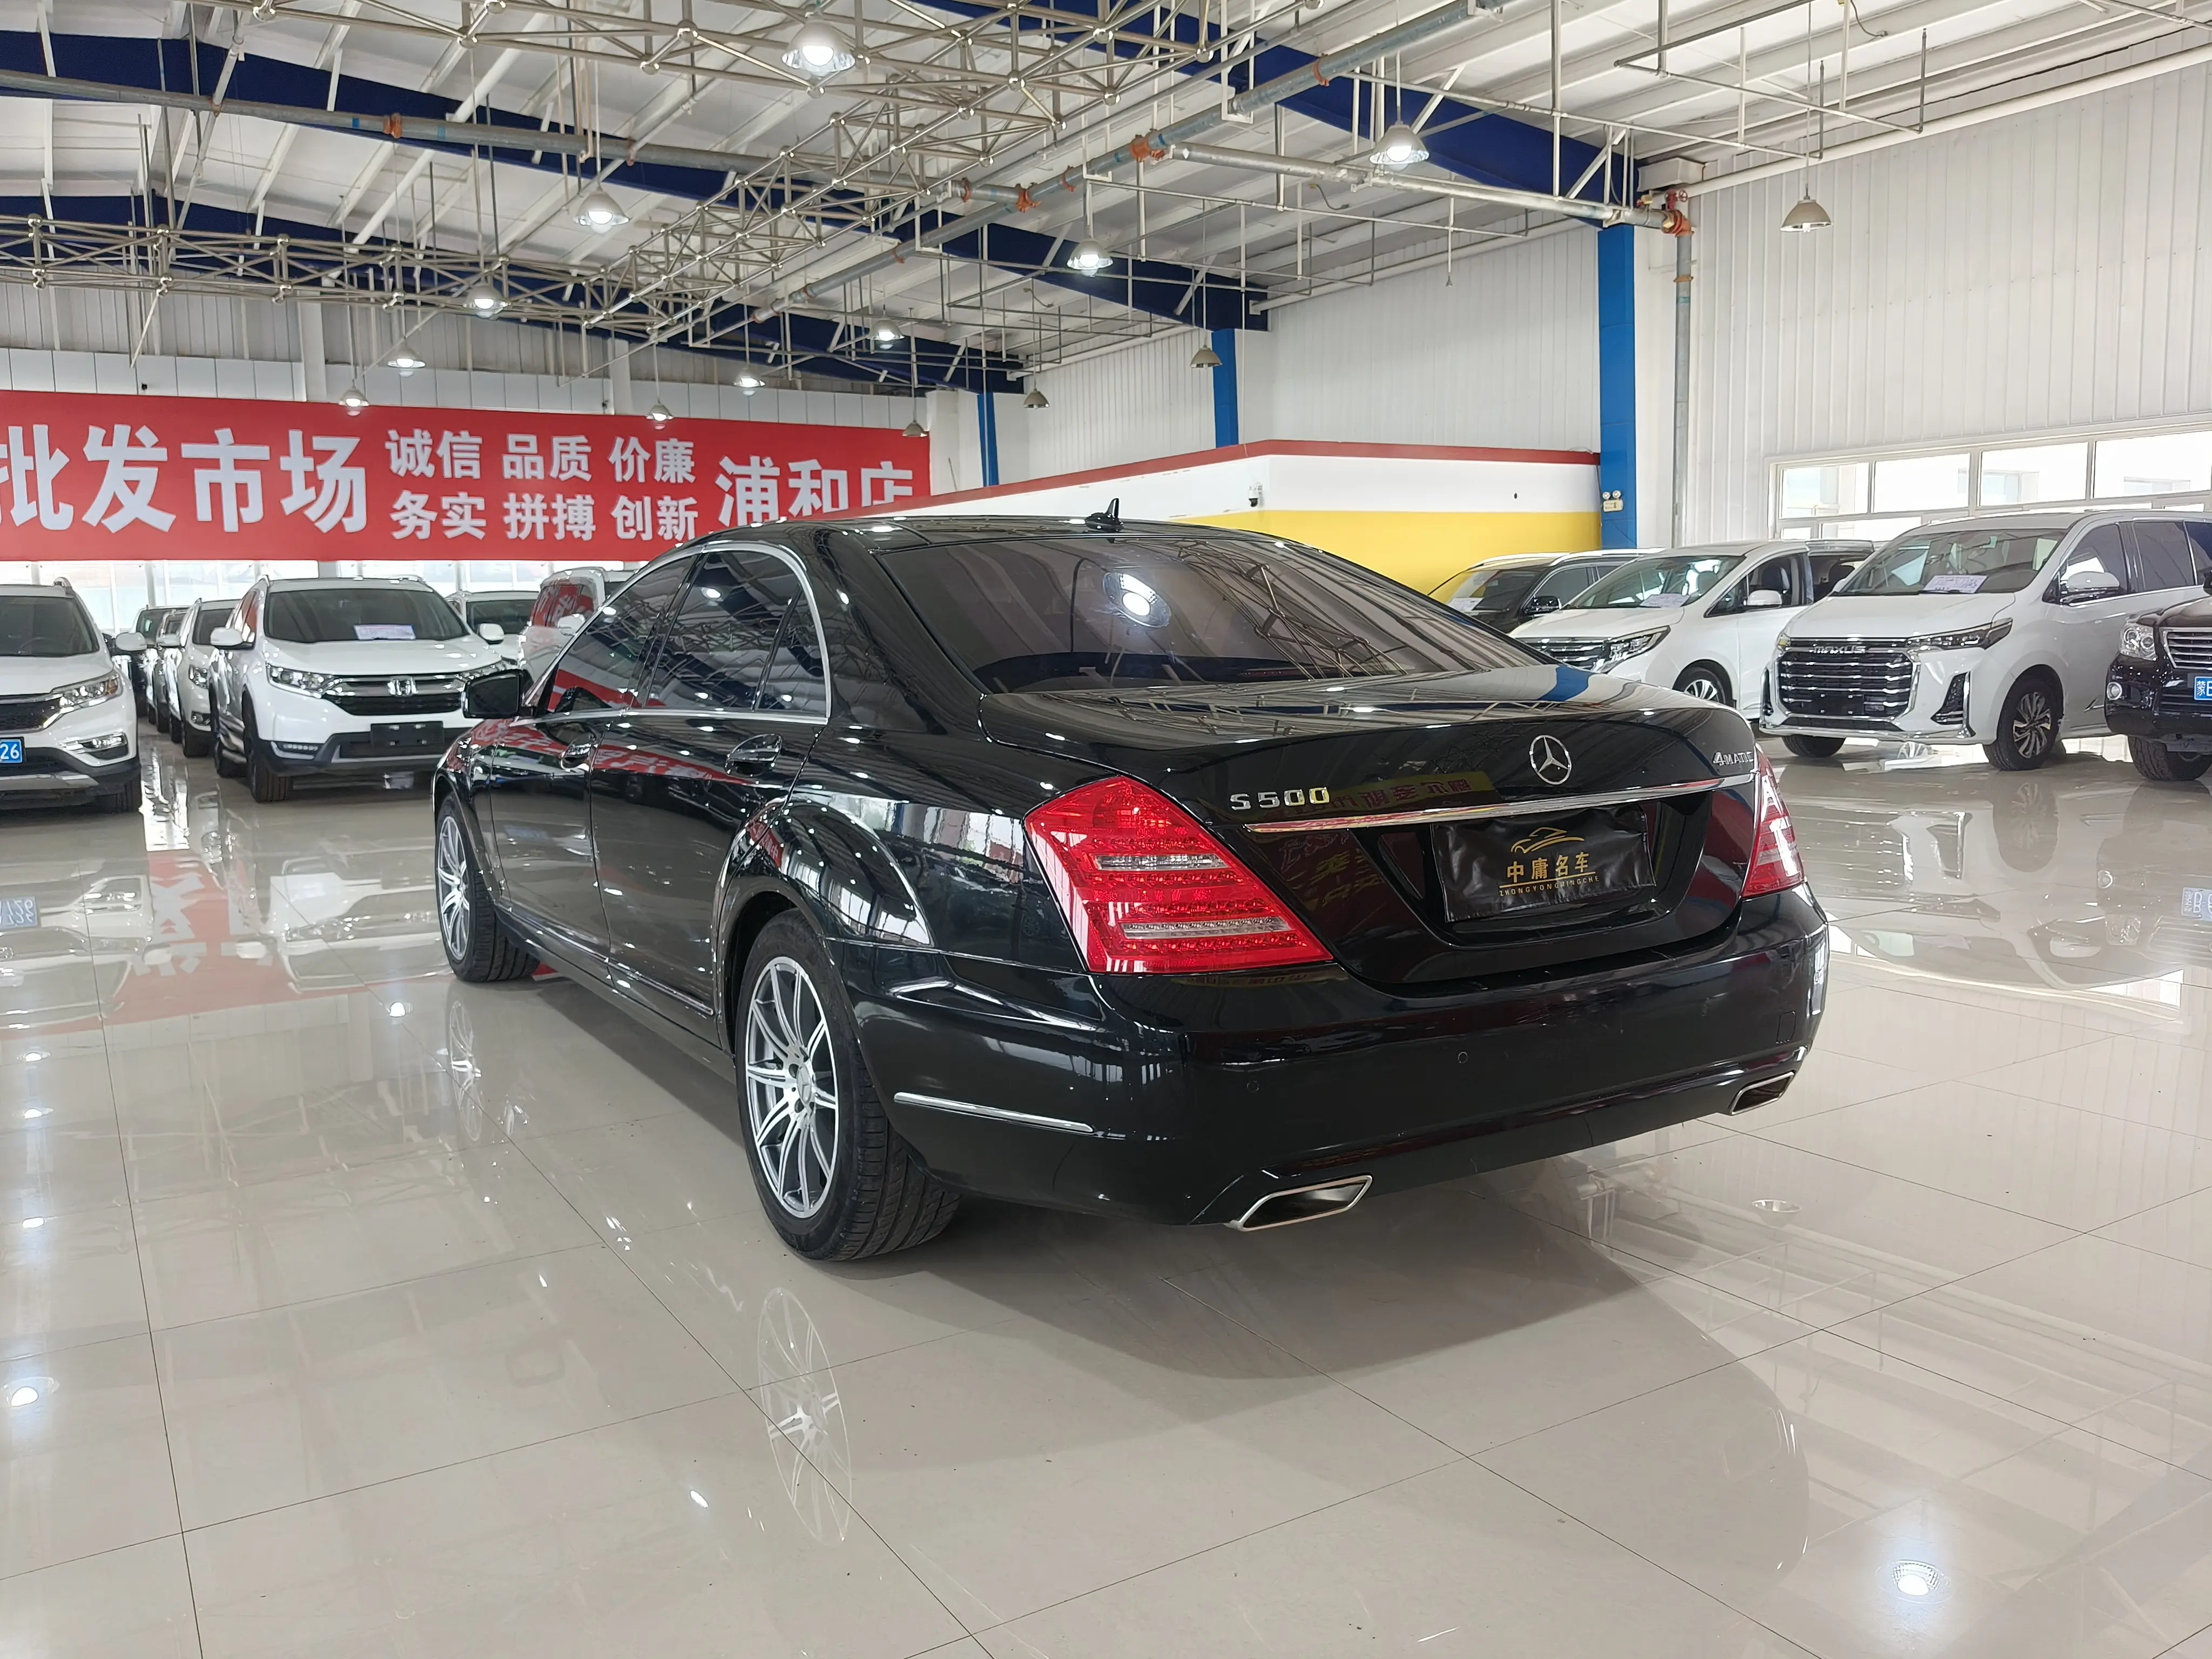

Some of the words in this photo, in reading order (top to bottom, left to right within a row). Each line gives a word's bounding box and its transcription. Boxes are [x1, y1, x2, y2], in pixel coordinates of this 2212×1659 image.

[0, 424, 368, 533] 批发市场
[385, 429, 482, 479] 诚信
[502, 434, 592, 482] 品质
[608, 436, 695, 483] 价廉
[389, 489, 486, 541] 务实
[503, 493, 596, 541] 拼搏
[612, 495, 698, 541] 创新
[0, 743, 20, 759] 26
[1507, 852, 1589, 883] 中庸名车
